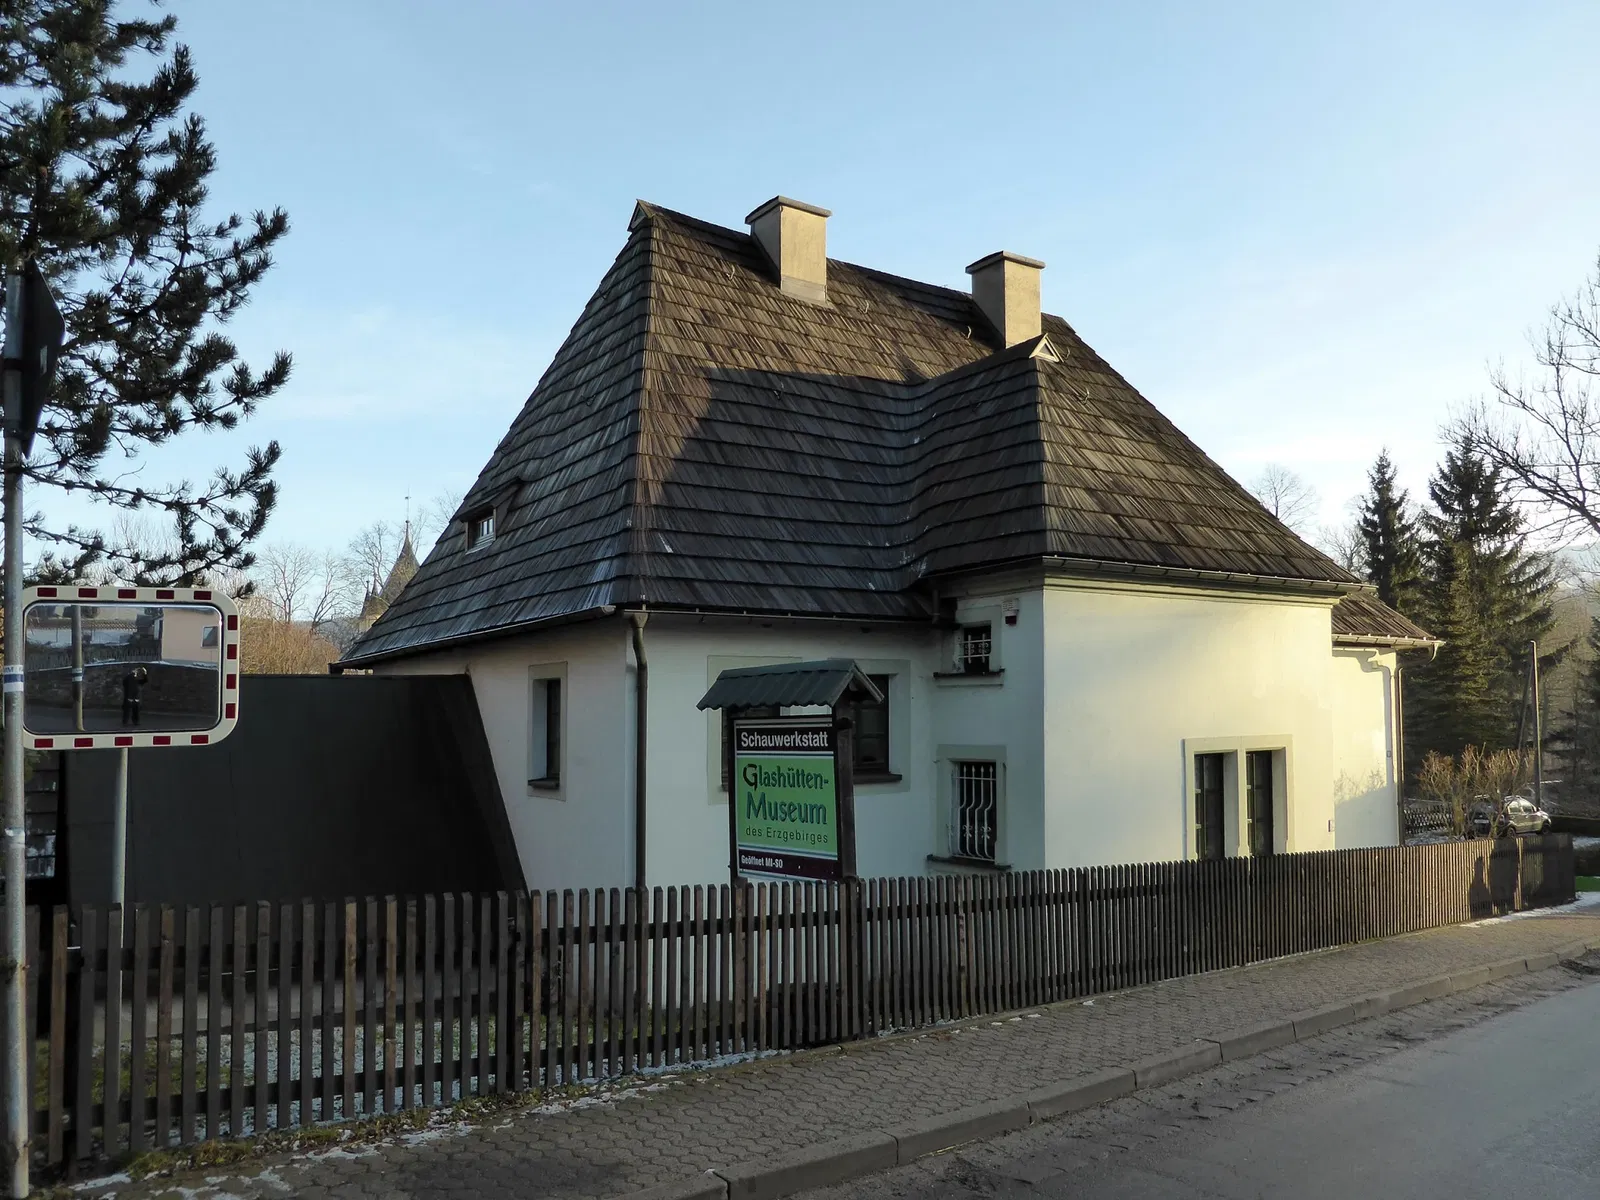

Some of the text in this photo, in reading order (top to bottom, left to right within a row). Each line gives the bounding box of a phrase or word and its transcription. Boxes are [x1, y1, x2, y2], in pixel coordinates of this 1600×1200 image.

[741, 731, 828, 747] Schauwerkstatt
[743, 763, 829, 791] Glashütten-
[746, 792, 828, 825] Museum
[745, 827, 828, 844] des Erzgebirges
[741, 855, 765, 867] Geöffnet
